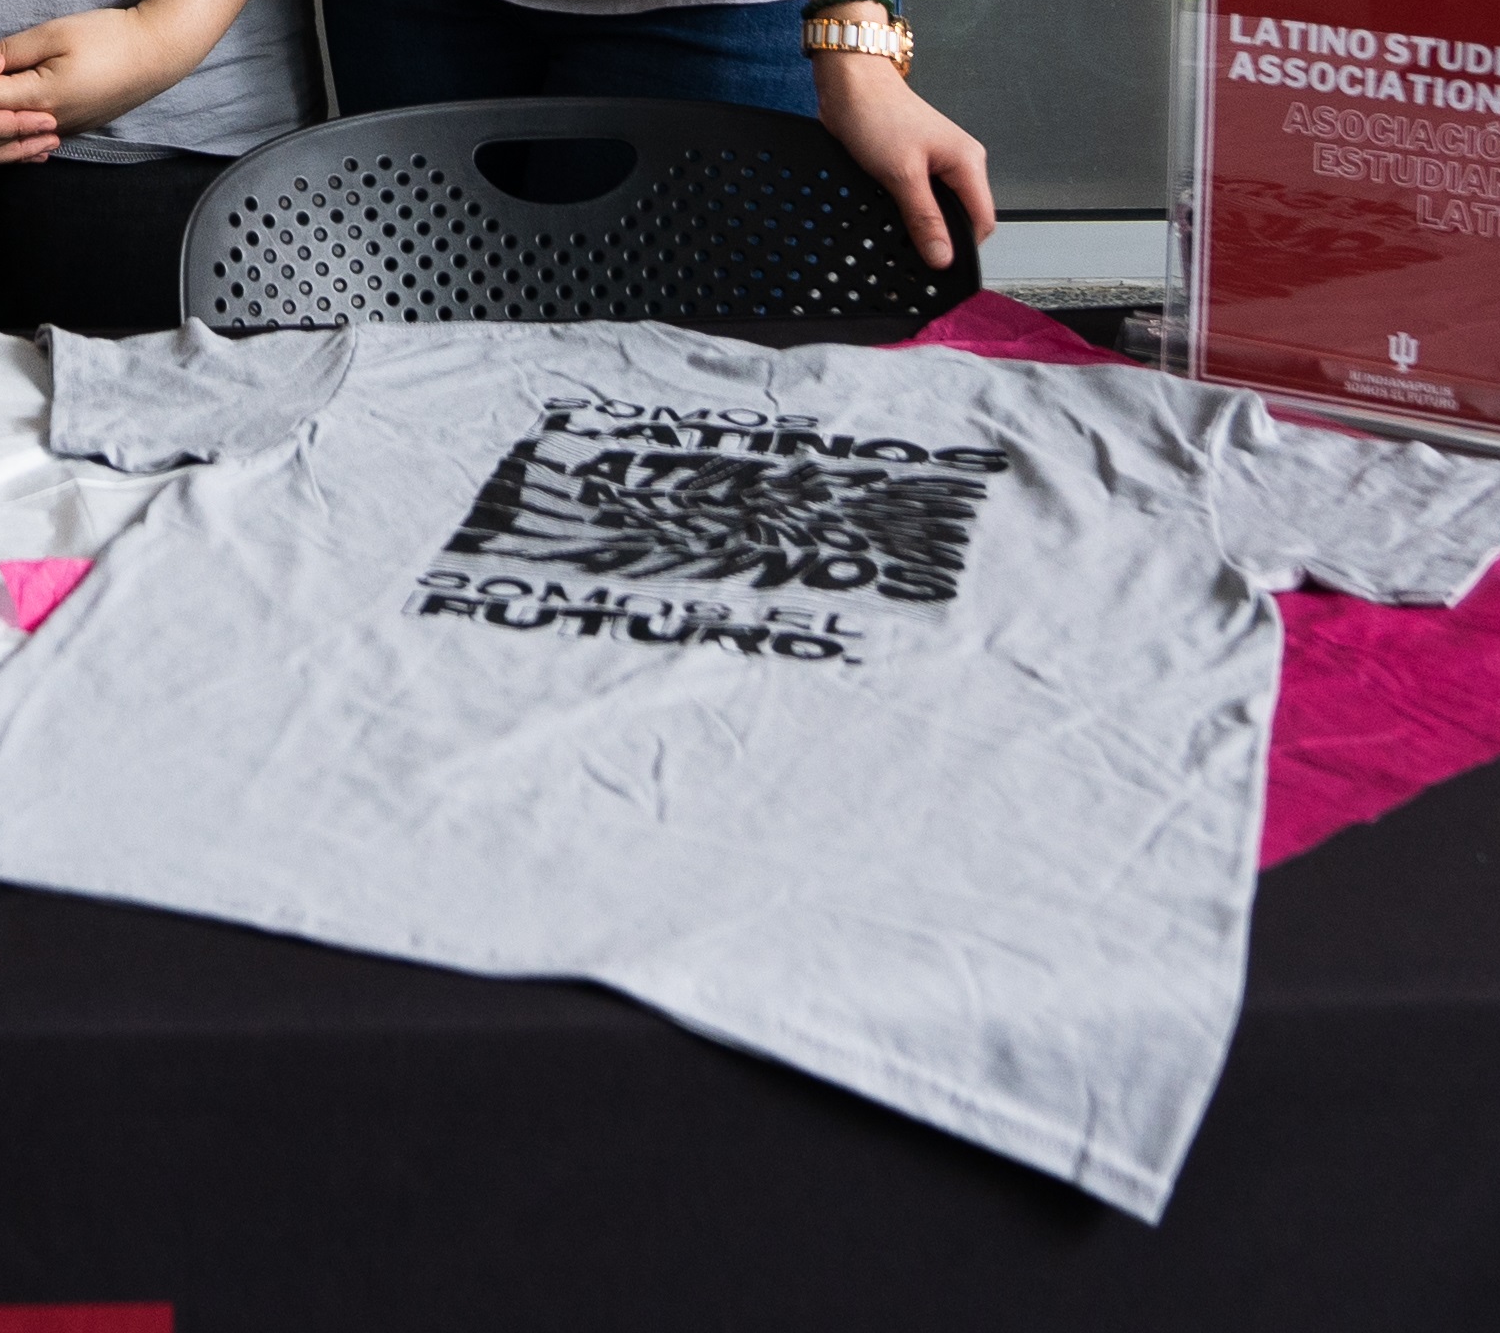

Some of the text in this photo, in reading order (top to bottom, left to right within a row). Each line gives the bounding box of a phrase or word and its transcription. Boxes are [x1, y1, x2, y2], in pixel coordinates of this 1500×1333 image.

[1230, 13, 1376, 61] LATINO
[545, 396, 819, 428] SOMOS
[417, 570, 863, 638] SOMOS EL
